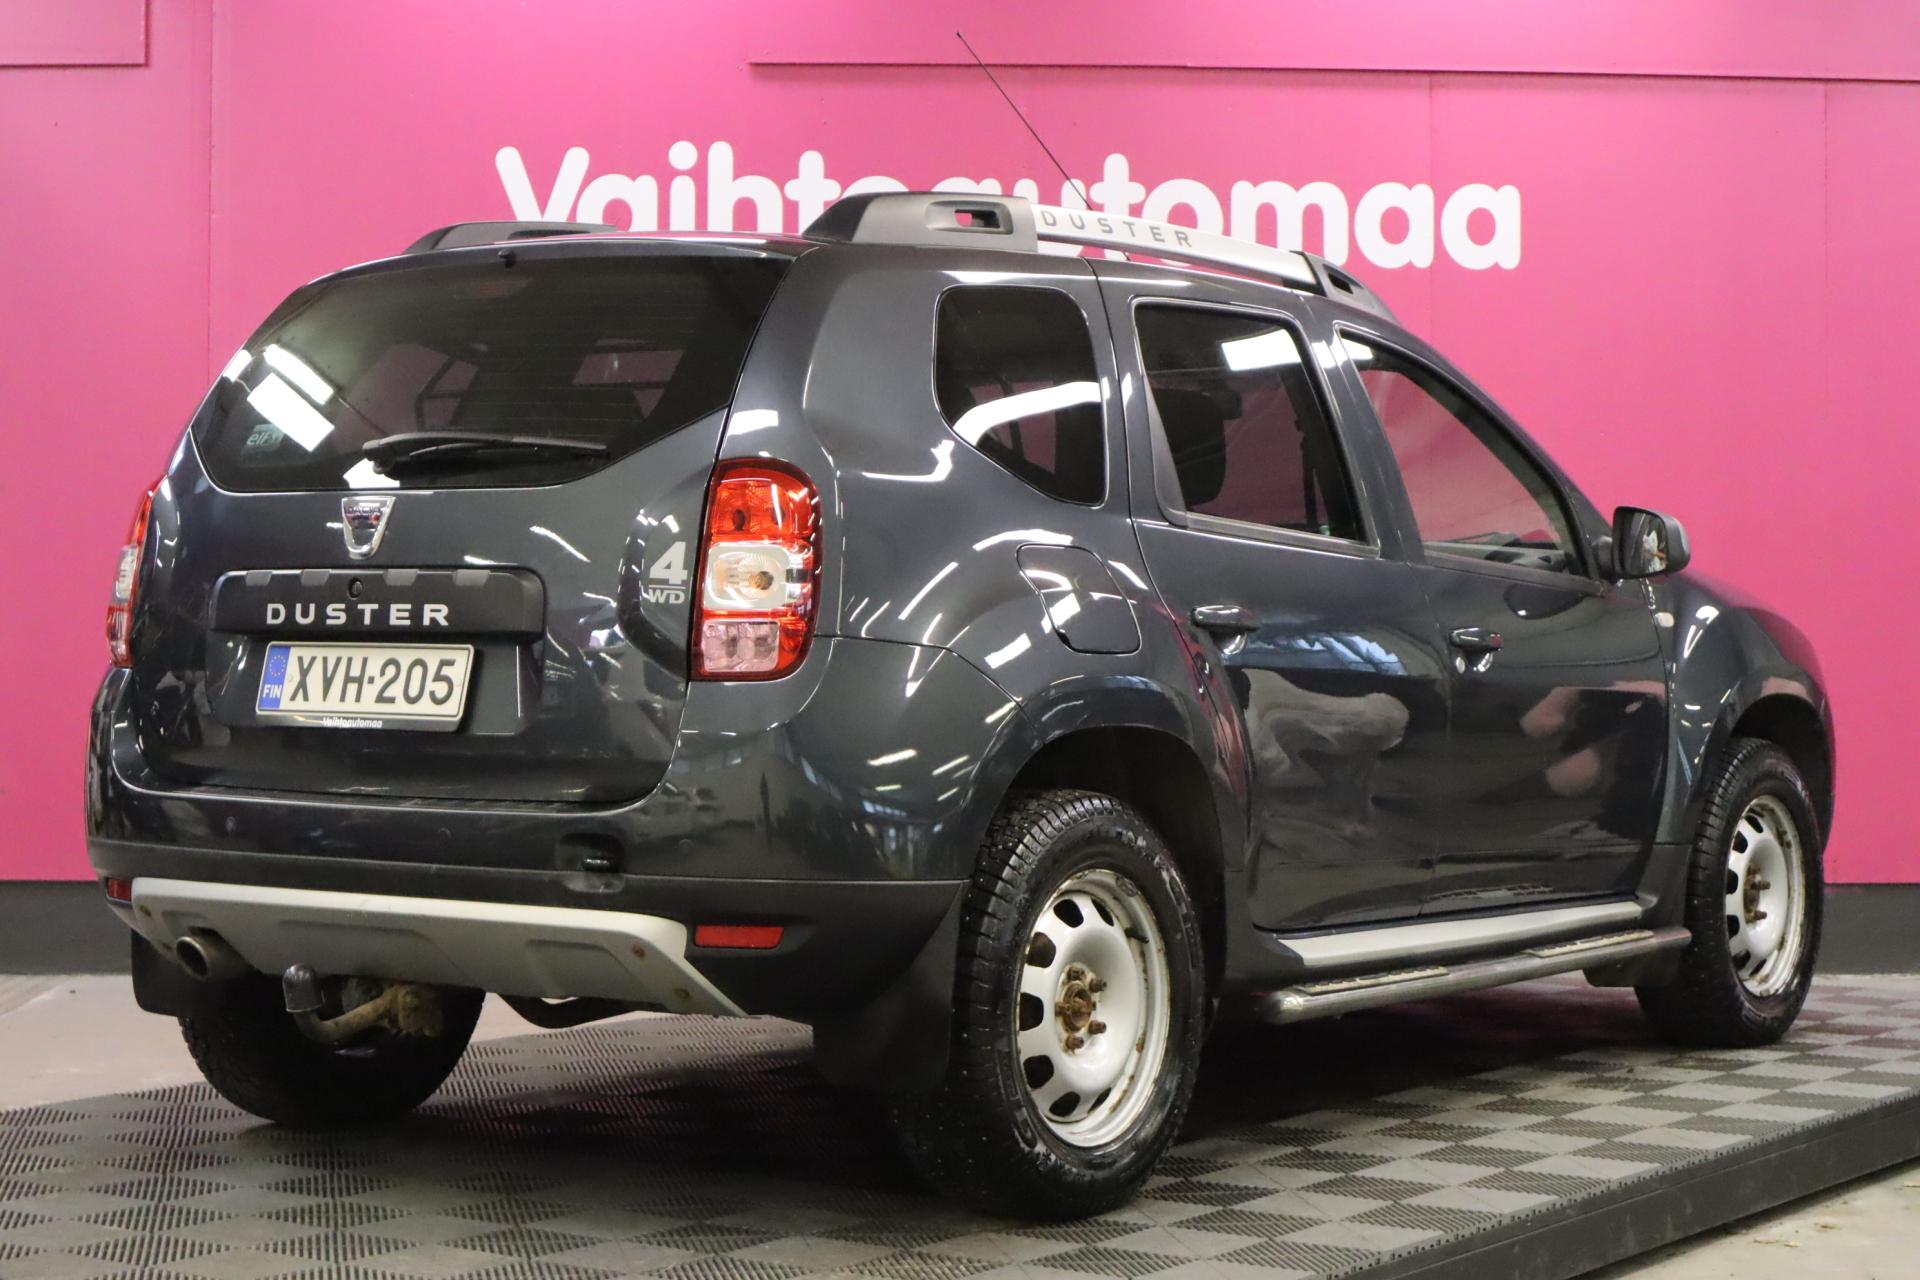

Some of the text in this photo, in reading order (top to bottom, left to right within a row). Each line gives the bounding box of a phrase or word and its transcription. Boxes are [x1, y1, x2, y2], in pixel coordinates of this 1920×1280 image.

[1040, 209, 1193, 249] DUSTER
[649, 541, 688, 585] 4
[648, 588, 686, 605] WD
[265, 602, 450, 627] DUSTER
[263, 683, 282, 698] FIN
[289, 655, 457, 706] XVH-205
